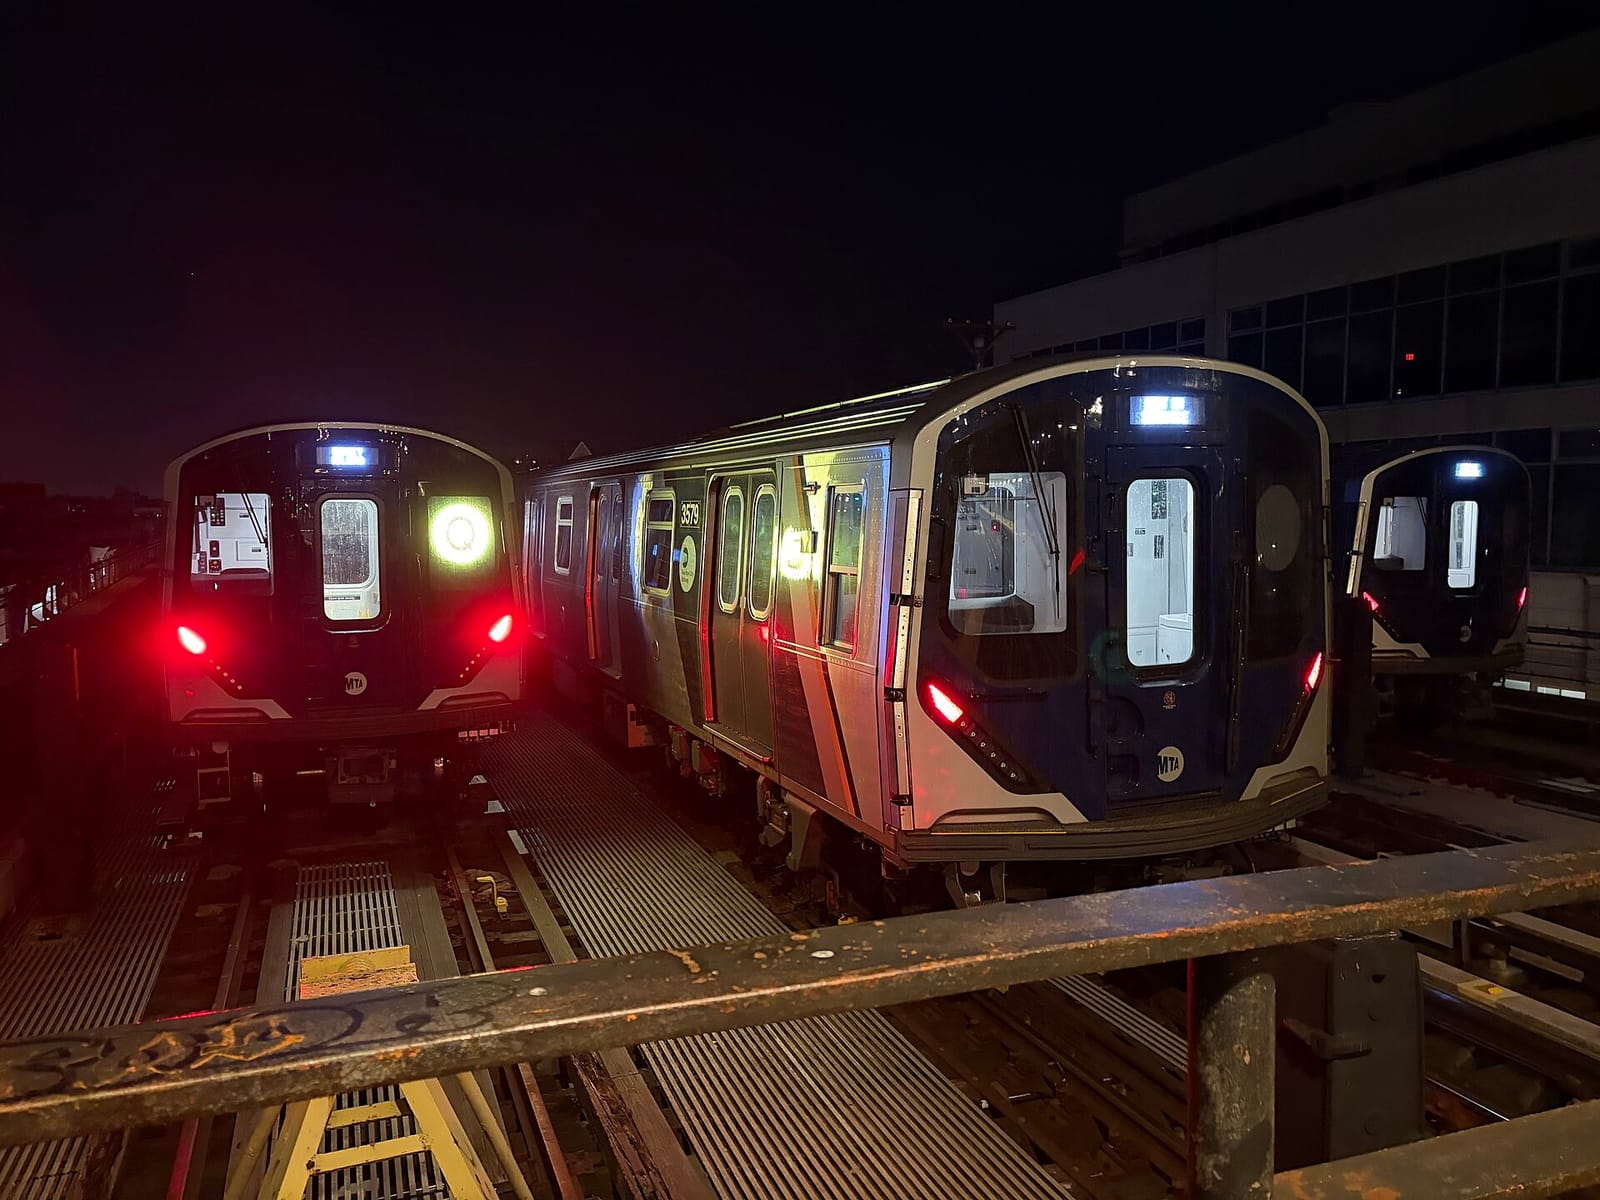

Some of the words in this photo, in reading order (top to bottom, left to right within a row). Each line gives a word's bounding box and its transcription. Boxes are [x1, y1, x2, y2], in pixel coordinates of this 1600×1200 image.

[681, 503, 699, 525] 3579
[446, 516, 475, 552] Q
[344, 677, 364, 691] MTA
[1157, 755, 1179, 775] MTA
